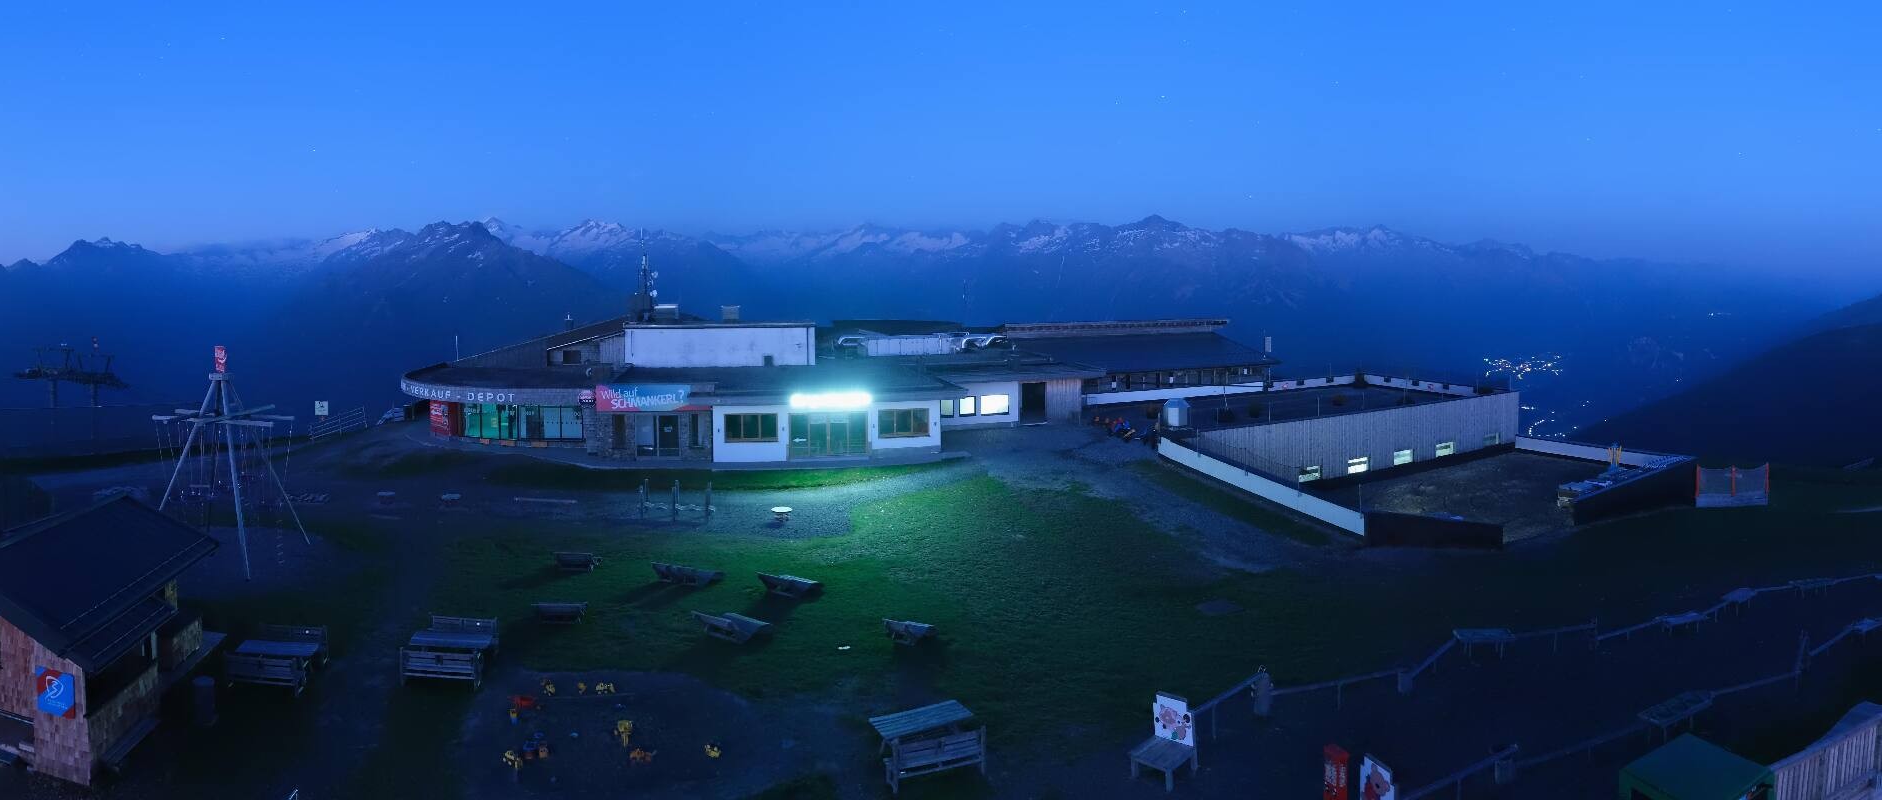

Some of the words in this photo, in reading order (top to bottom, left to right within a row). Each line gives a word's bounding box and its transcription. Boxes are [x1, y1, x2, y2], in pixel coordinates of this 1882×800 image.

[410, 385, 451, 399] VERKAUF
[467, 392, 515, 402] DEPOT
[601, 389, 621, 400] Wild
[623, 386, 638, 398] auf
[610, 389, 685, 409] SCHMANKERL?
